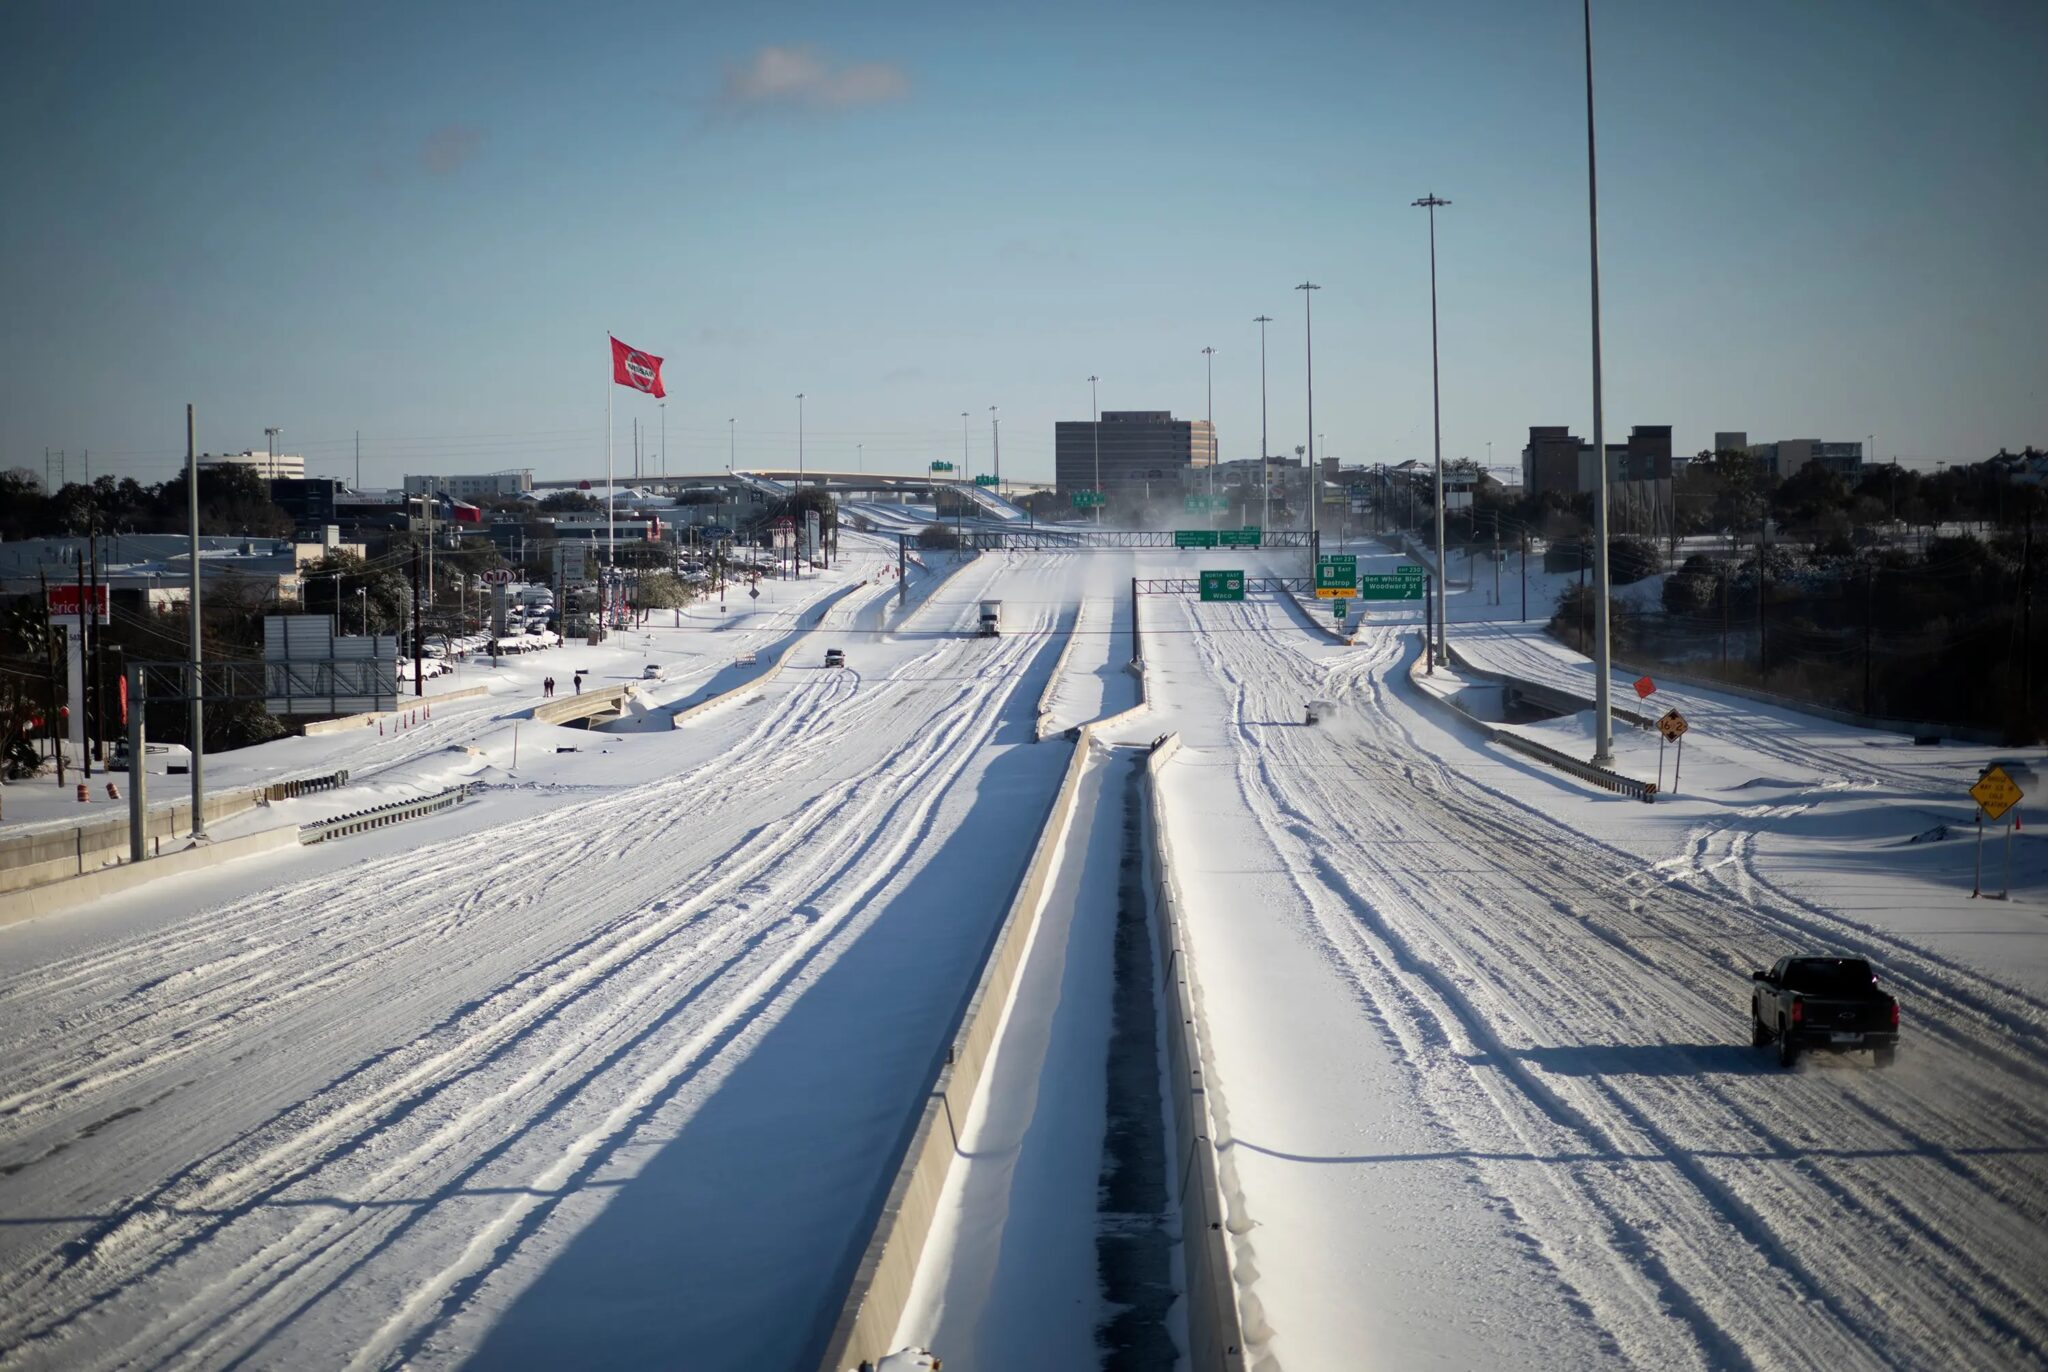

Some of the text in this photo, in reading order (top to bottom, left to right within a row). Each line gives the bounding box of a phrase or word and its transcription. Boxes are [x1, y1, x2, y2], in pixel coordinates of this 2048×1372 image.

[627, 362, 654, 377] NISSAN
[486, 571, 508, 582] KIA
[1322, 580, 1350, 588] Bastrop
